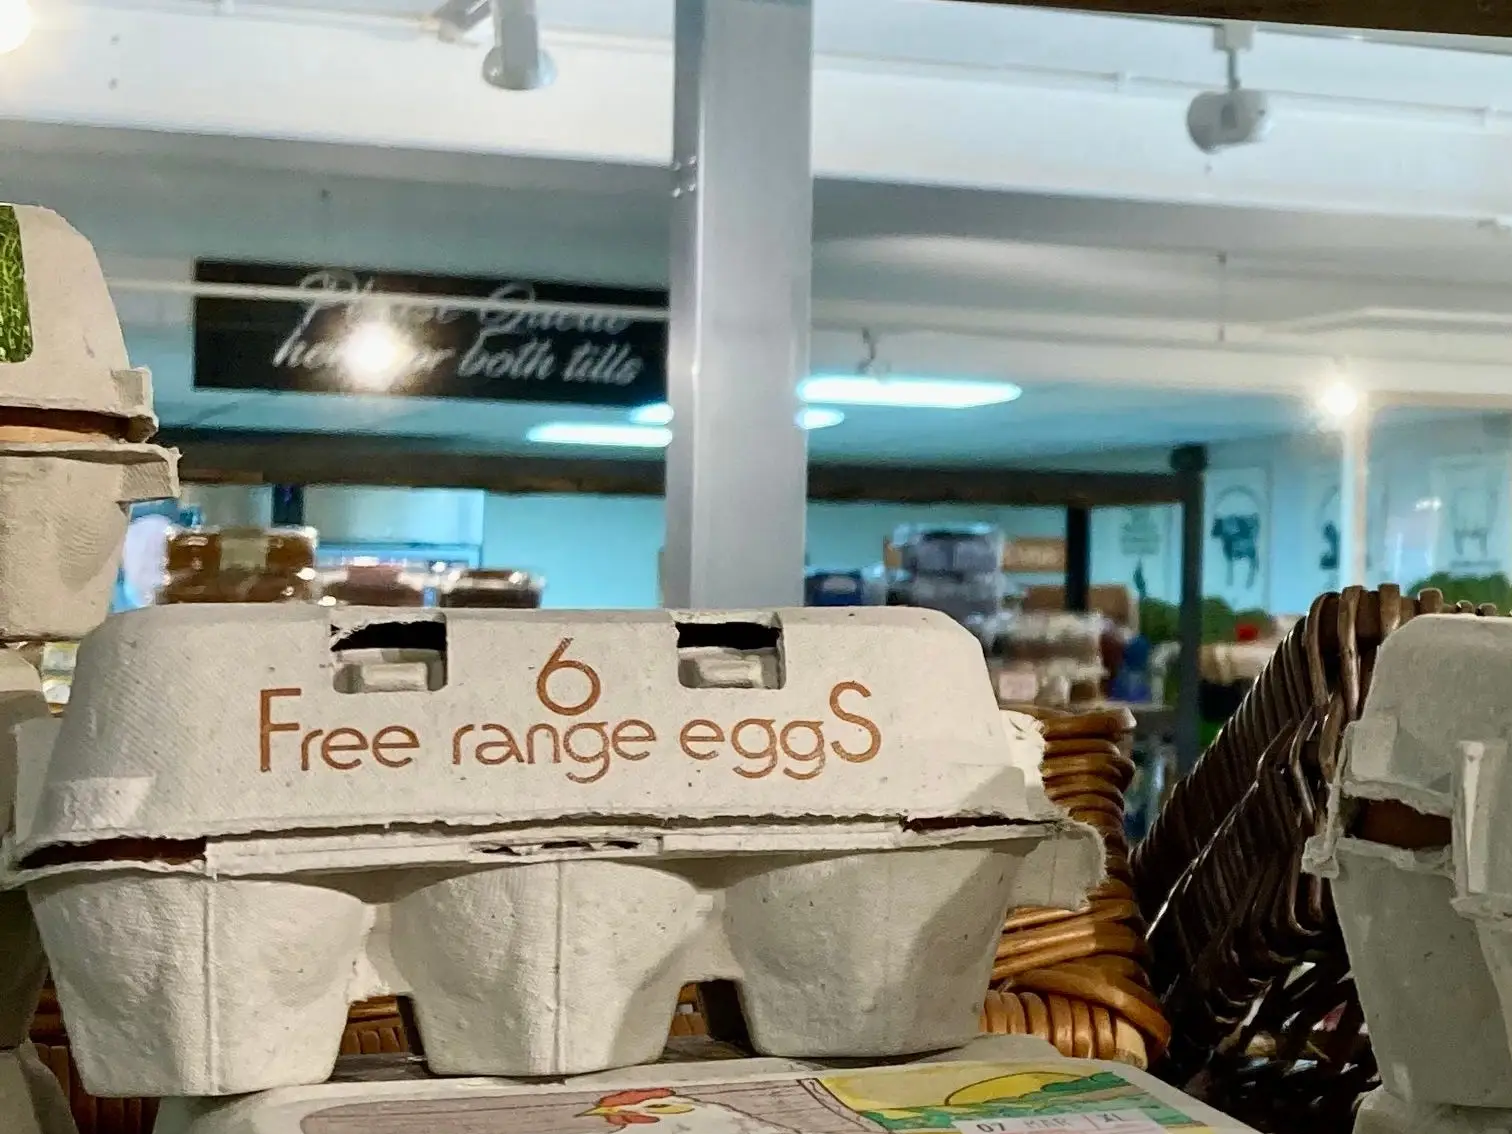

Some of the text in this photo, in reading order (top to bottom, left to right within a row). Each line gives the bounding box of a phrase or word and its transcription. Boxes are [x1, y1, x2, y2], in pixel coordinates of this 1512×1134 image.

[458, 330, 557, 381] both
[561, 339, 645, 387] tills
[537, 638, 601, 716] 6
[258, 680, 882, 784] Free range eggS
